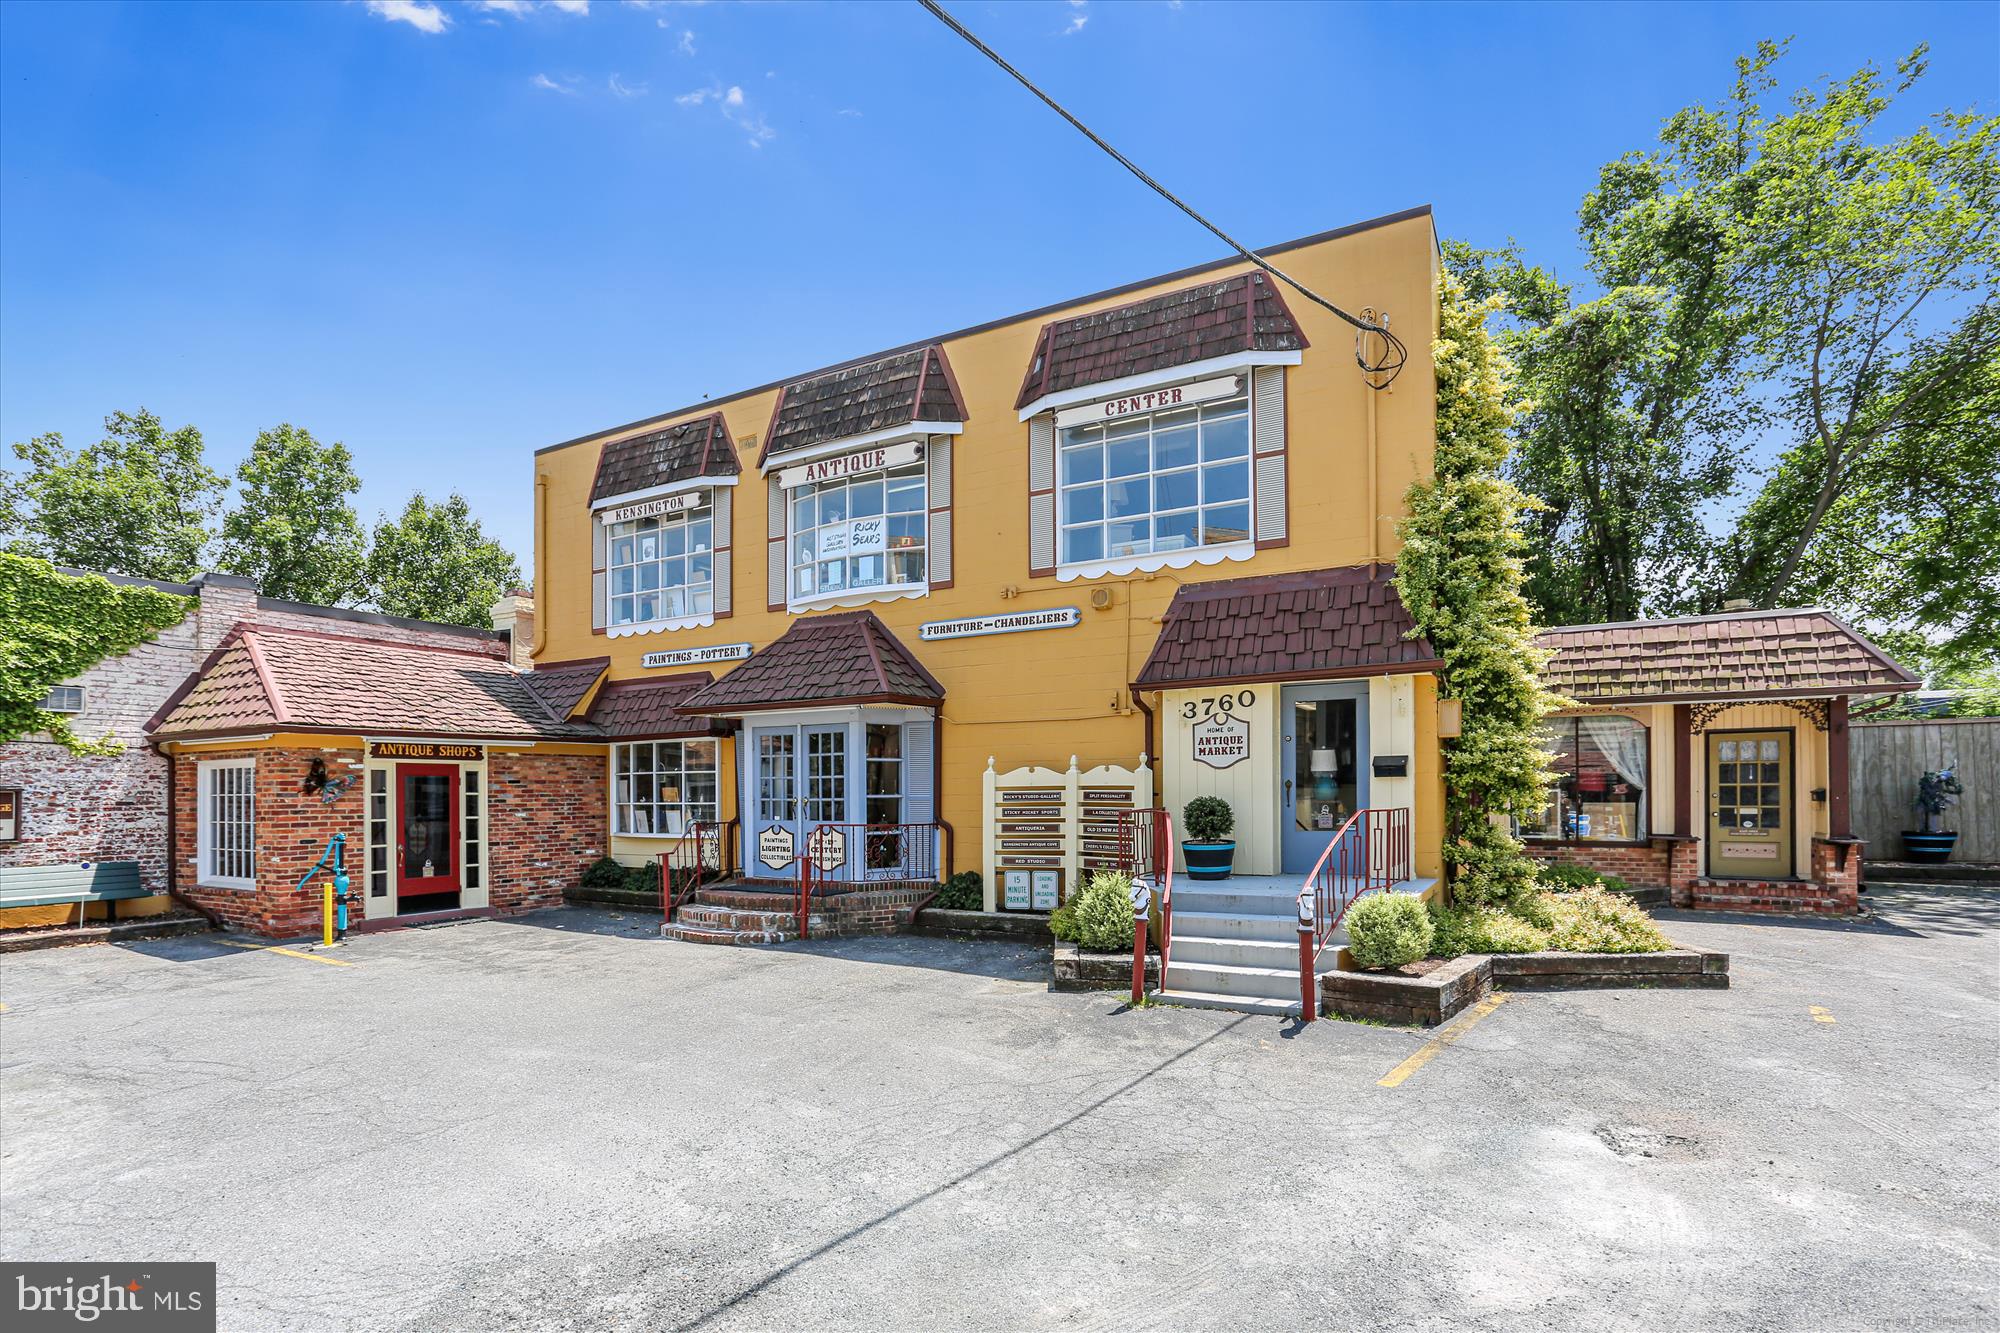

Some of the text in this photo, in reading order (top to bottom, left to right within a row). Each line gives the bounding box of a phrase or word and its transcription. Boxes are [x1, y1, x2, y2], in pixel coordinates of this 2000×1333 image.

[1105, 388, 1183, 416] CENTER
[806, 449, 886, 481] ANTIQUE
[615, 496, 684, 521] KENSINGTON
[854, 520, 881, 533] RICKY
[852, 533, 881, 546] SEARS
[852, 577, 883, 587] GALLER
[648, 651, 692, 665] PAINTINGS
[700, 646, 742, 660] POTTERY
[1182, 689, 1256, 719] 3760
[1206, 726, 1224, 734] HOME
[1197, 735, 1244, 746] ANTIQUE
[379, 743, 477, 758] ANTIQUE SHOPS
[1198, 746, 1244, 756] MARKET
[761, 845, 791, 853] LIGHTING
[810, 846, 842, 854] CETURY
[1013, 875, 1021, 884] 15
[1007, 886, 1027, 894] MINUTE
[1007, 896, 1028, 904] PARKING
